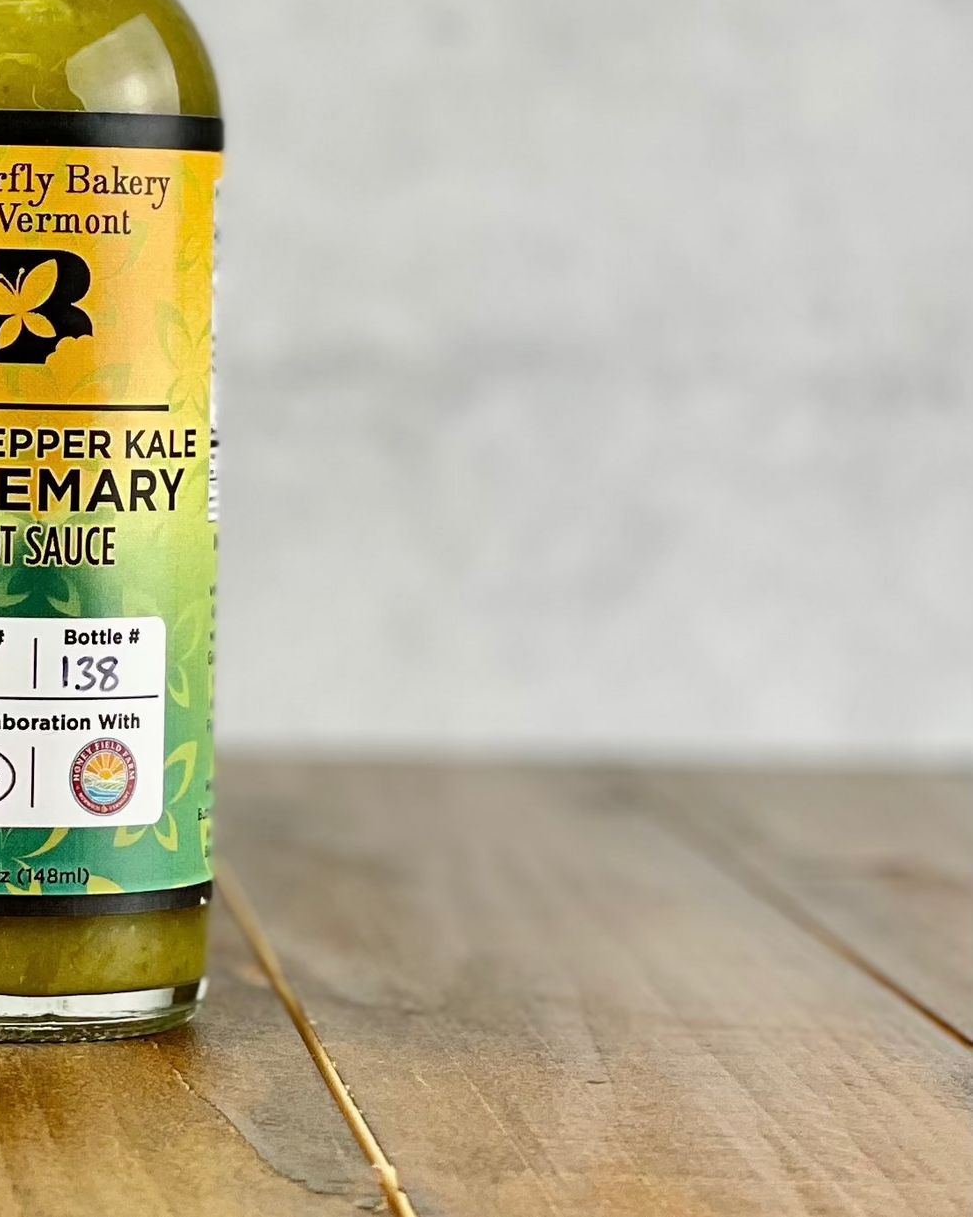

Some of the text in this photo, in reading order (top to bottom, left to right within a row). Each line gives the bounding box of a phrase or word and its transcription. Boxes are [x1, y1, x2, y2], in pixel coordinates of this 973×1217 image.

[66, 164, 171, 210] Bakery
[126, 429, 196, 459] KALE
[26, 526, 116, 566] SAUCE
[64, 628, 140, 645] Bottle #
[99, 713, 141, 730] With
[73, 741, 135, 782] HONEY FIELD FARM
[17, 867, 90, 885] (148ml)
